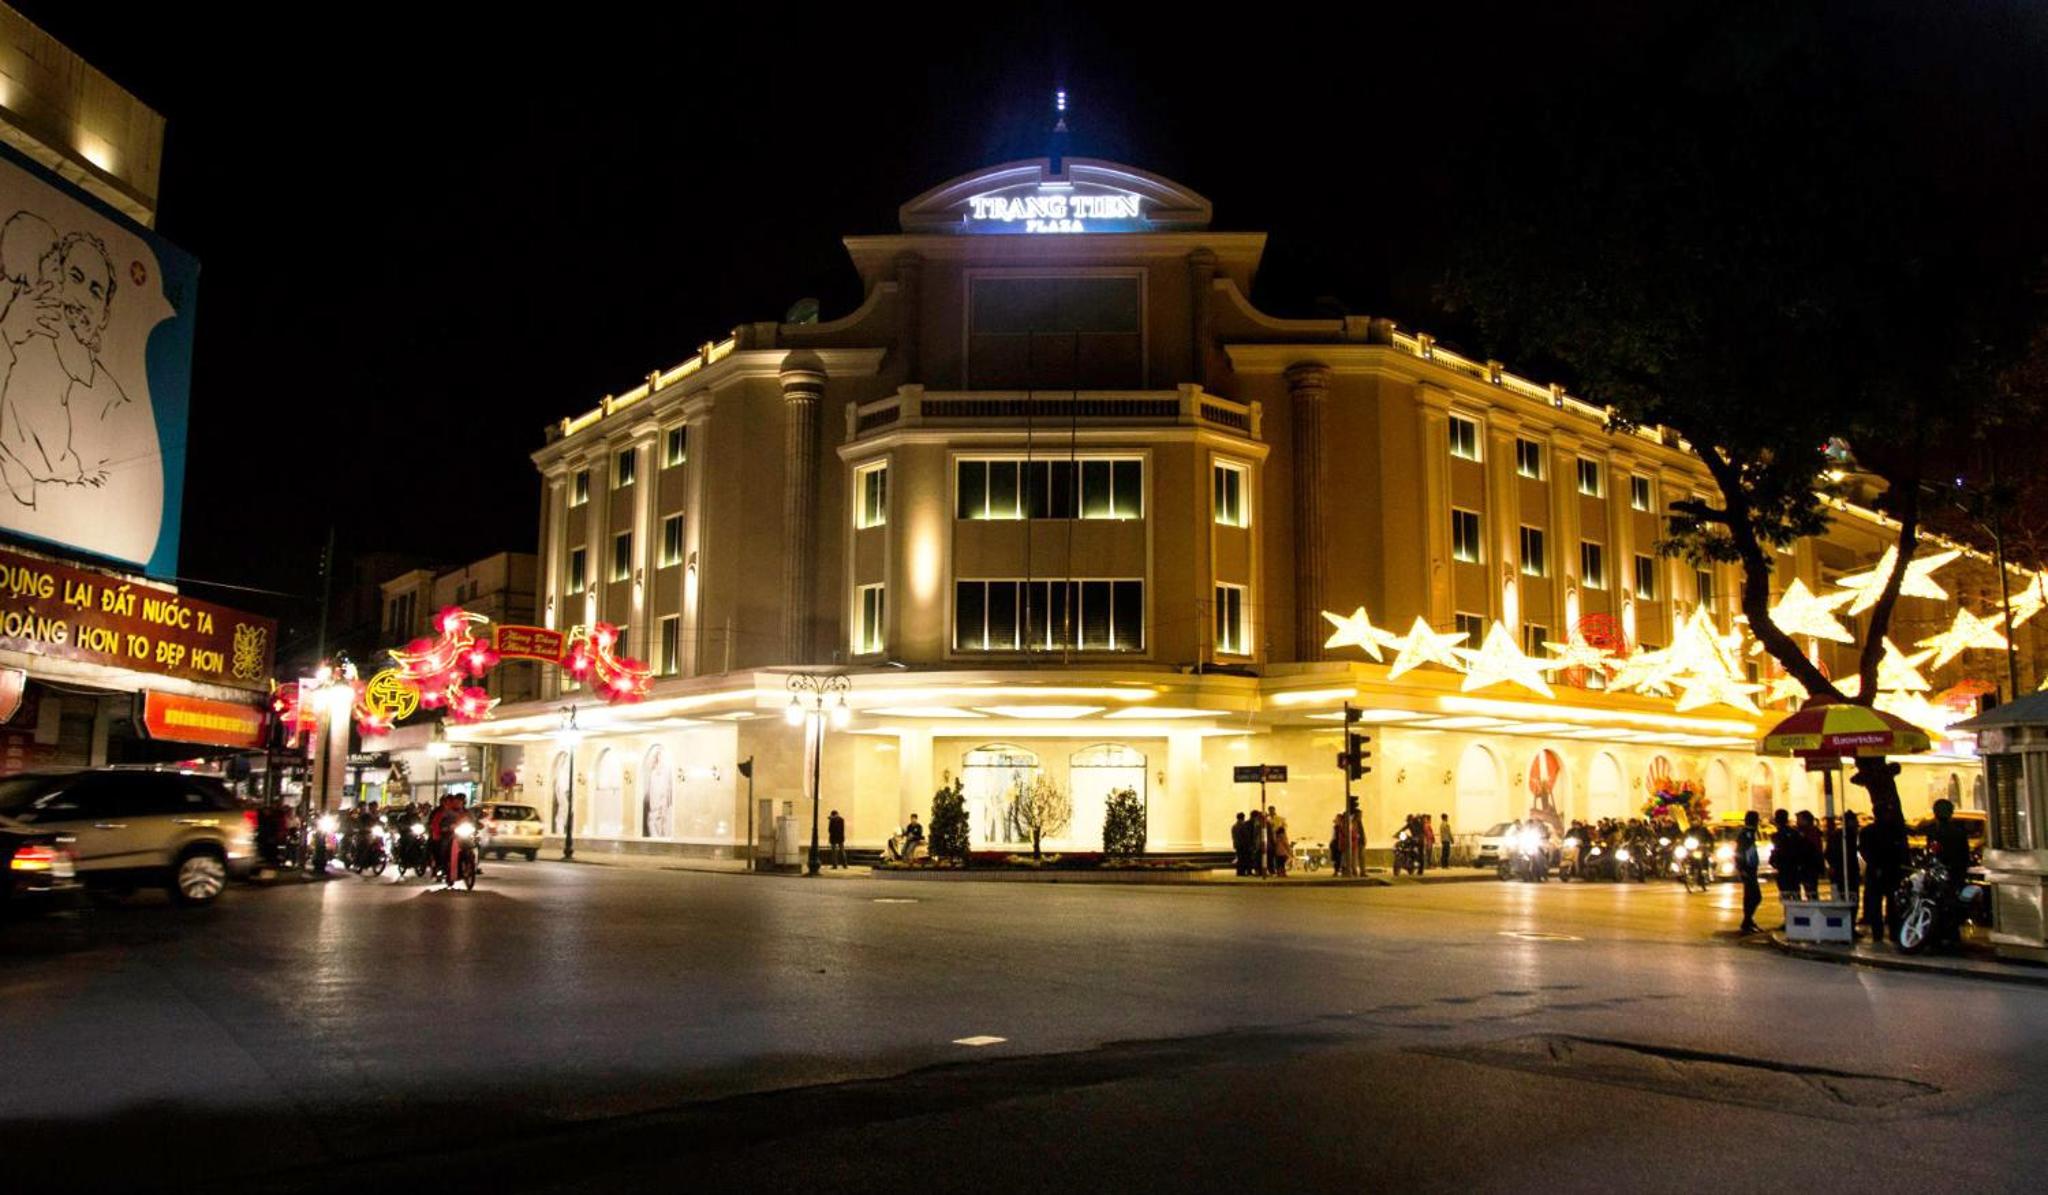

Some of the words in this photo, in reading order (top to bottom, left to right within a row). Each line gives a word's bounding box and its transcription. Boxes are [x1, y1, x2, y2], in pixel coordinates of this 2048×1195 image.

[970, 196, 1068, 221] TRANG
[1070, 195, 1141, 218] TIEN
[1025, 219, 1084, 233] PLAZA
[64, 580, 92, 611] LẠI
[101, 584, 136, 617] ĐẤT
[142, 598, 192, 629] NƯỚC
[197, 611, 213, 635] TA
[78, 625, 119, 654] HƠN
[127, 634, 149, 659] TO
[156, 640, 185, 669] ĐẸP
[191, 647, 224, 673] HƠN
